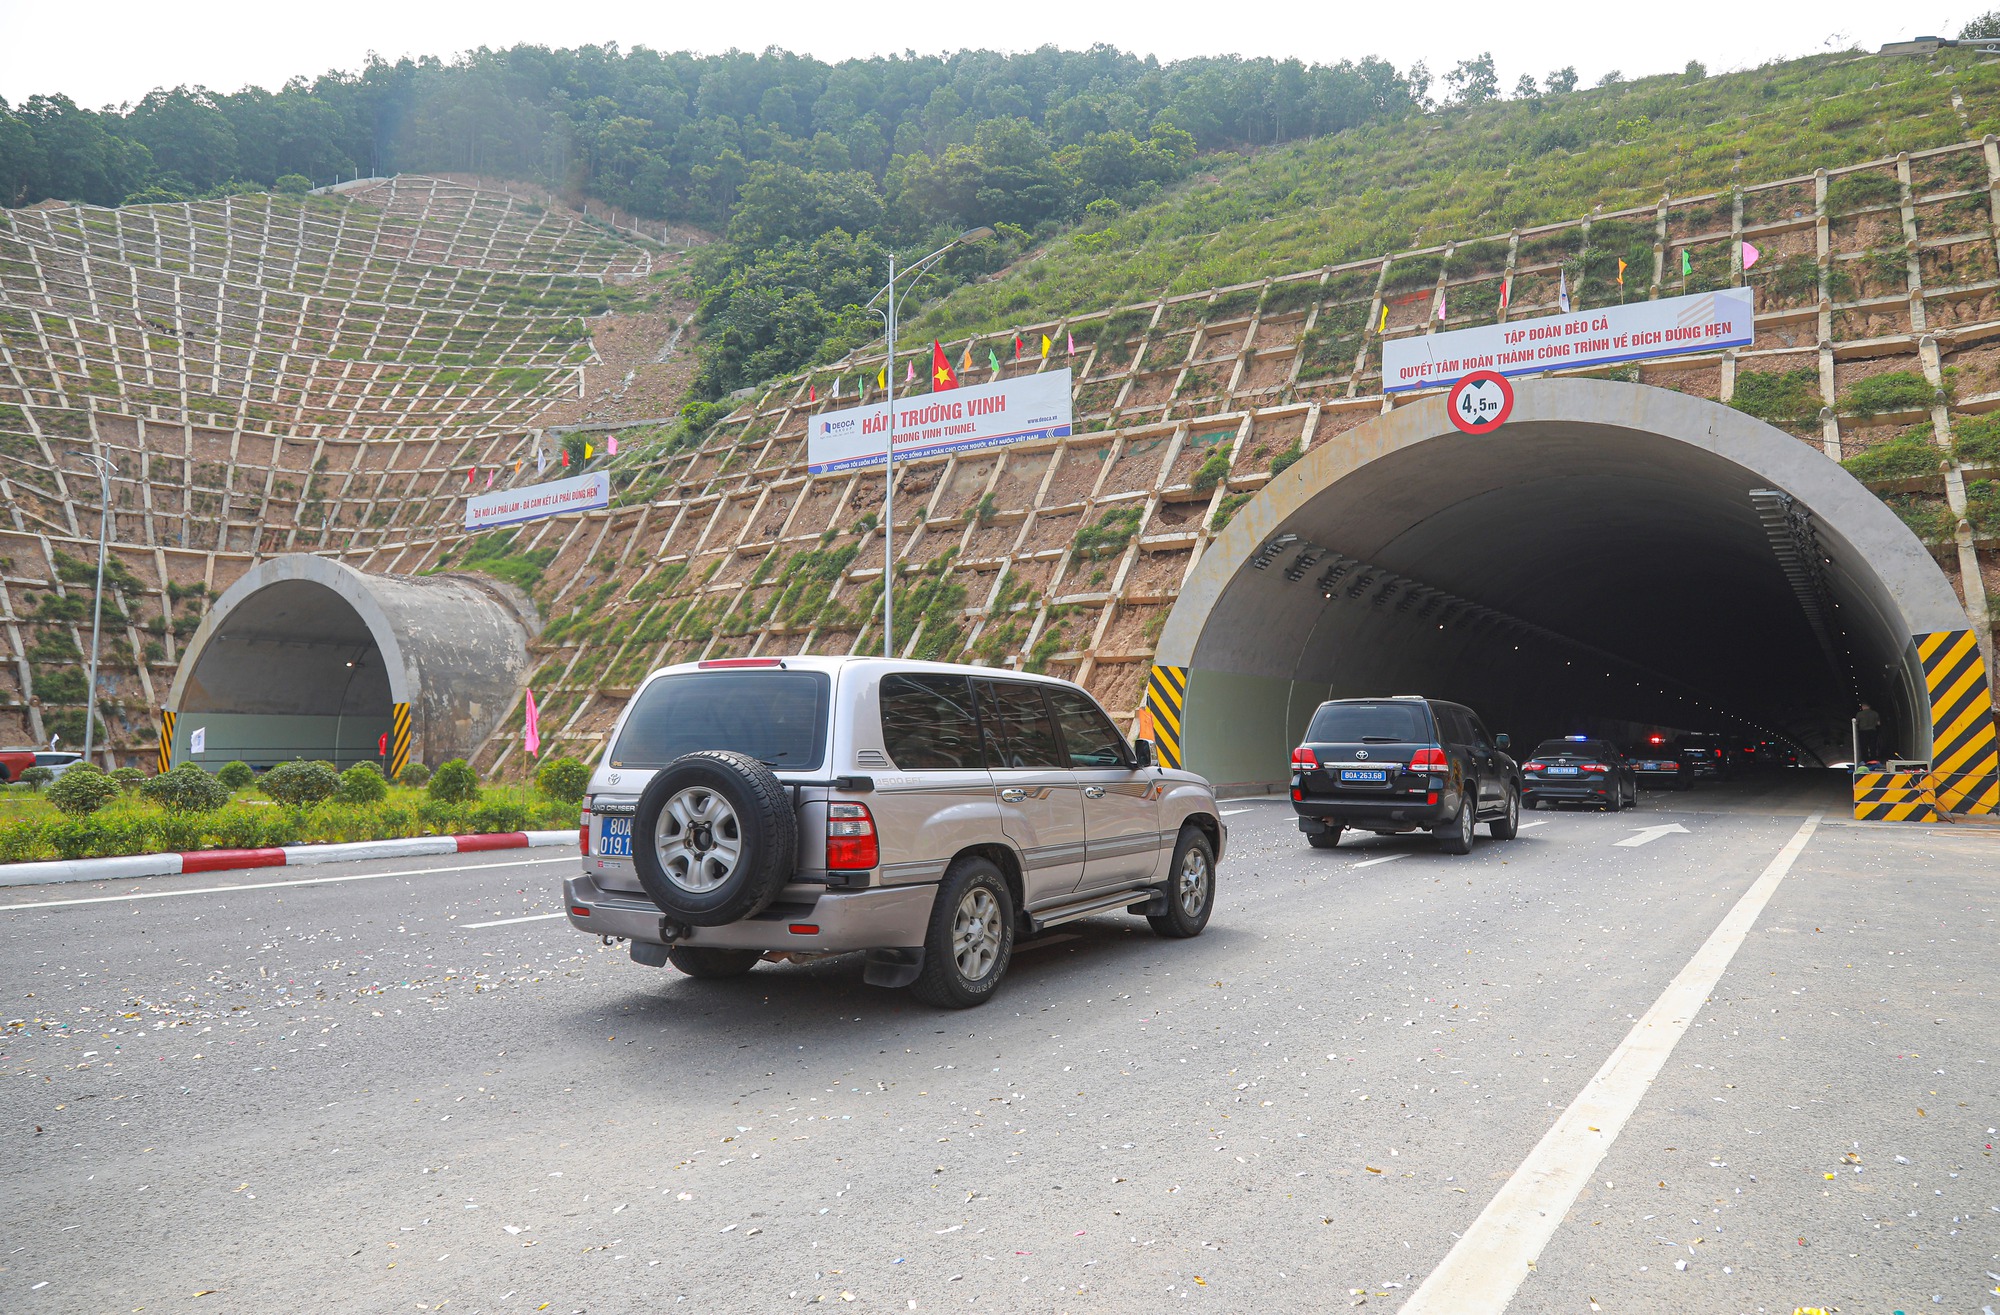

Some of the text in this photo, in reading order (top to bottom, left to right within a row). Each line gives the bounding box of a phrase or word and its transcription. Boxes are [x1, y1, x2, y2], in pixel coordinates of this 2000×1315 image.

[1504, 314, 1609, 346] TẬP ĐOÀN ĐÈO CẢ
[1400, 321, 1732, 379] QUYẾT TÂM HOÀN THÀNH CÔNG TRÌNH VỀ ĐÍCH ĐÚNG HẸN
[901, 402, 962, 428] TRƯỜNG
[967, 395, 1006, 417] VINH
[832, 419, 855, 430] DEOCA
[892, 422, 976, 444] RUONG VINH TUNNEL
[1026, 434, 1039, 442] NAM
[531, 498, 542, 508] CAM
[600, 836, 632, 855] 019.1
